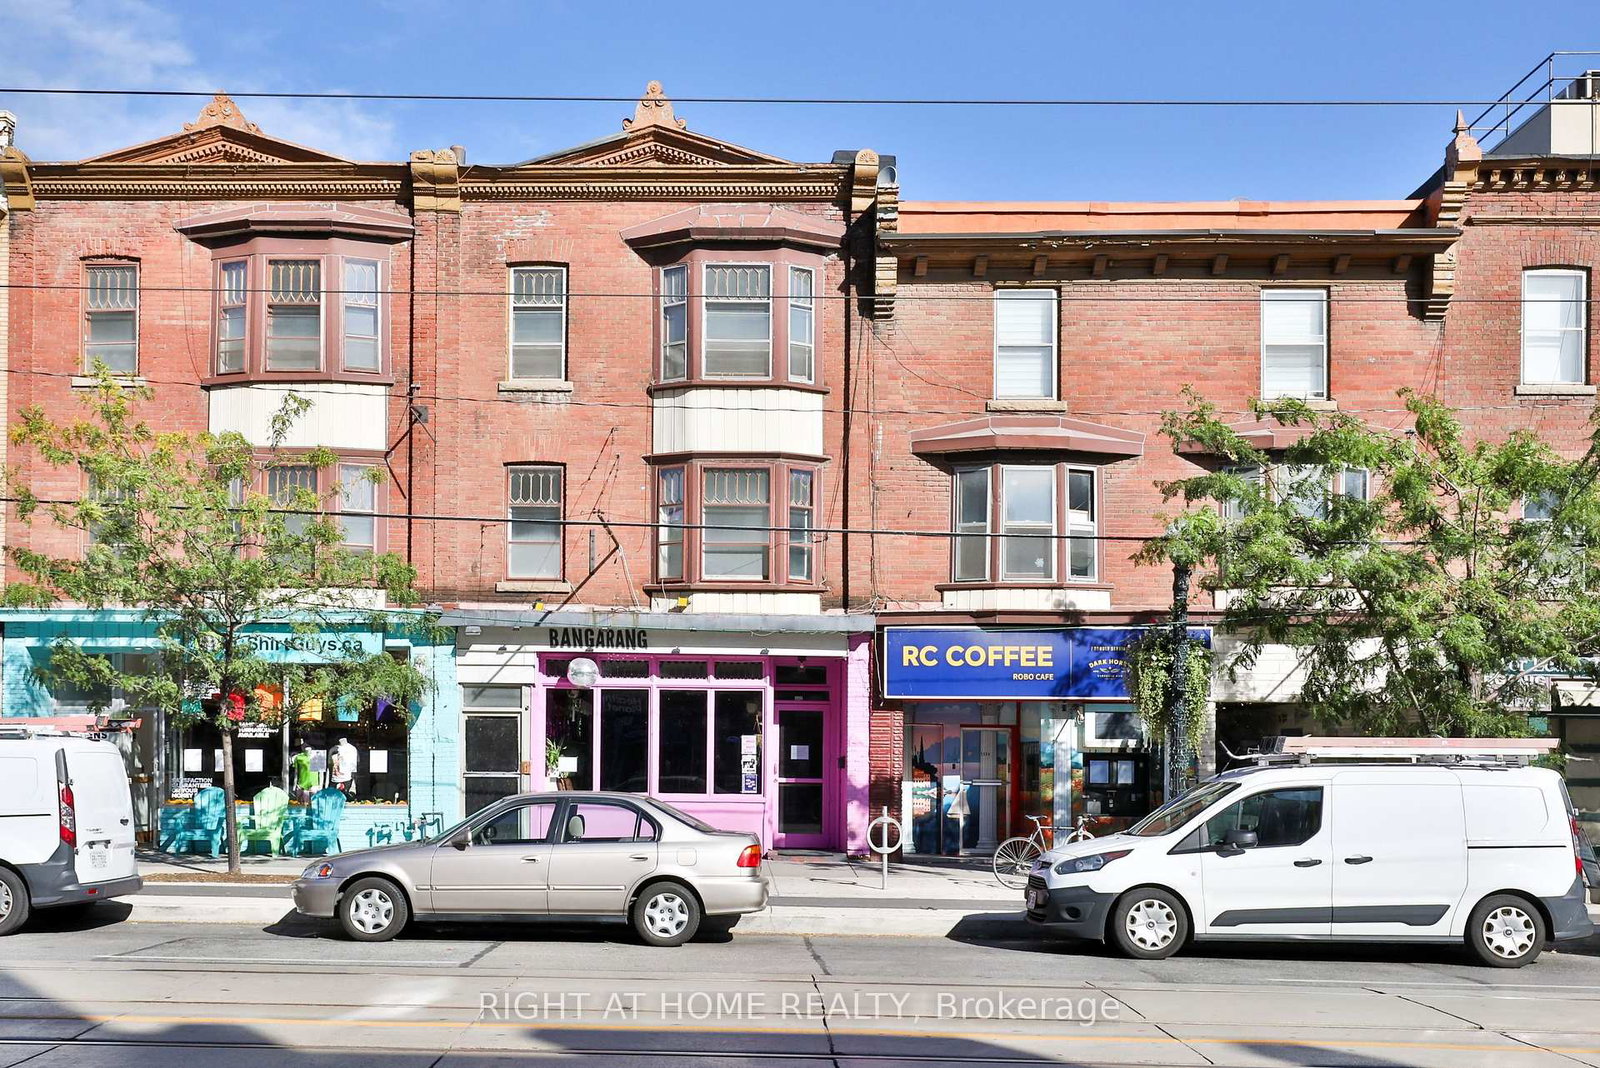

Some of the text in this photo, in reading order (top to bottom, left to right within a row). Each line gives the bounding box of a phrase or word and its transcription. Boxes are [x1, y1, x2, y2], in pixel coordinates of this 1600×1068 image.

[549, 627, 648, 649] BANGARANG
[902, 645, 1054, 667] RC COFFEE
[1088, 660, 1107, 668] DARK
[1013, 673, 1054, 681] ROBO CAFE
